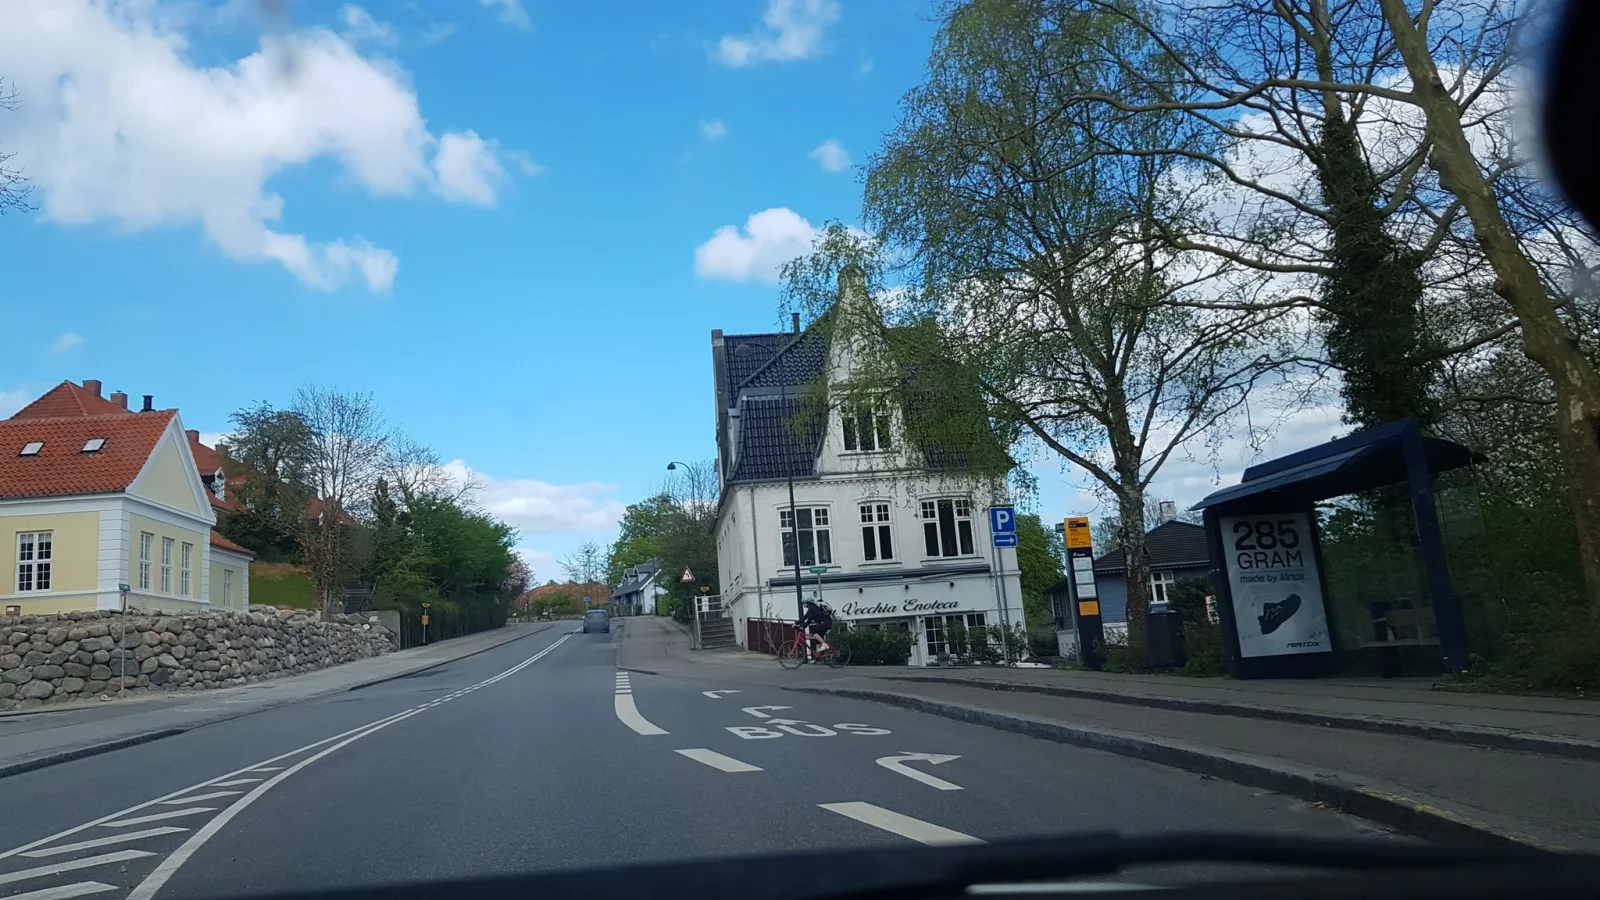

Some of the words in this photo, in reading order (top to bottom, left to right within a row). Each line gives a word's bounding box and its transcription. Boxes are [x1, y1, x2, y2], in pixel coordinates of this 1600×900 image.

[996, 510, 1010, 530] P
[1233, 519, 1299, 550] 285
[1237, 551, 1304, 570] GRAM
[1240, 574, 1265, 583] made
[1266, 573, 1277, 583] by
[1280, 572, 1305, 581] Airtox
[841, 601, 898, 616] Vecchia
[902, 598, 959, 612] Enoteca
[724, 723, 892, 740] BUS
